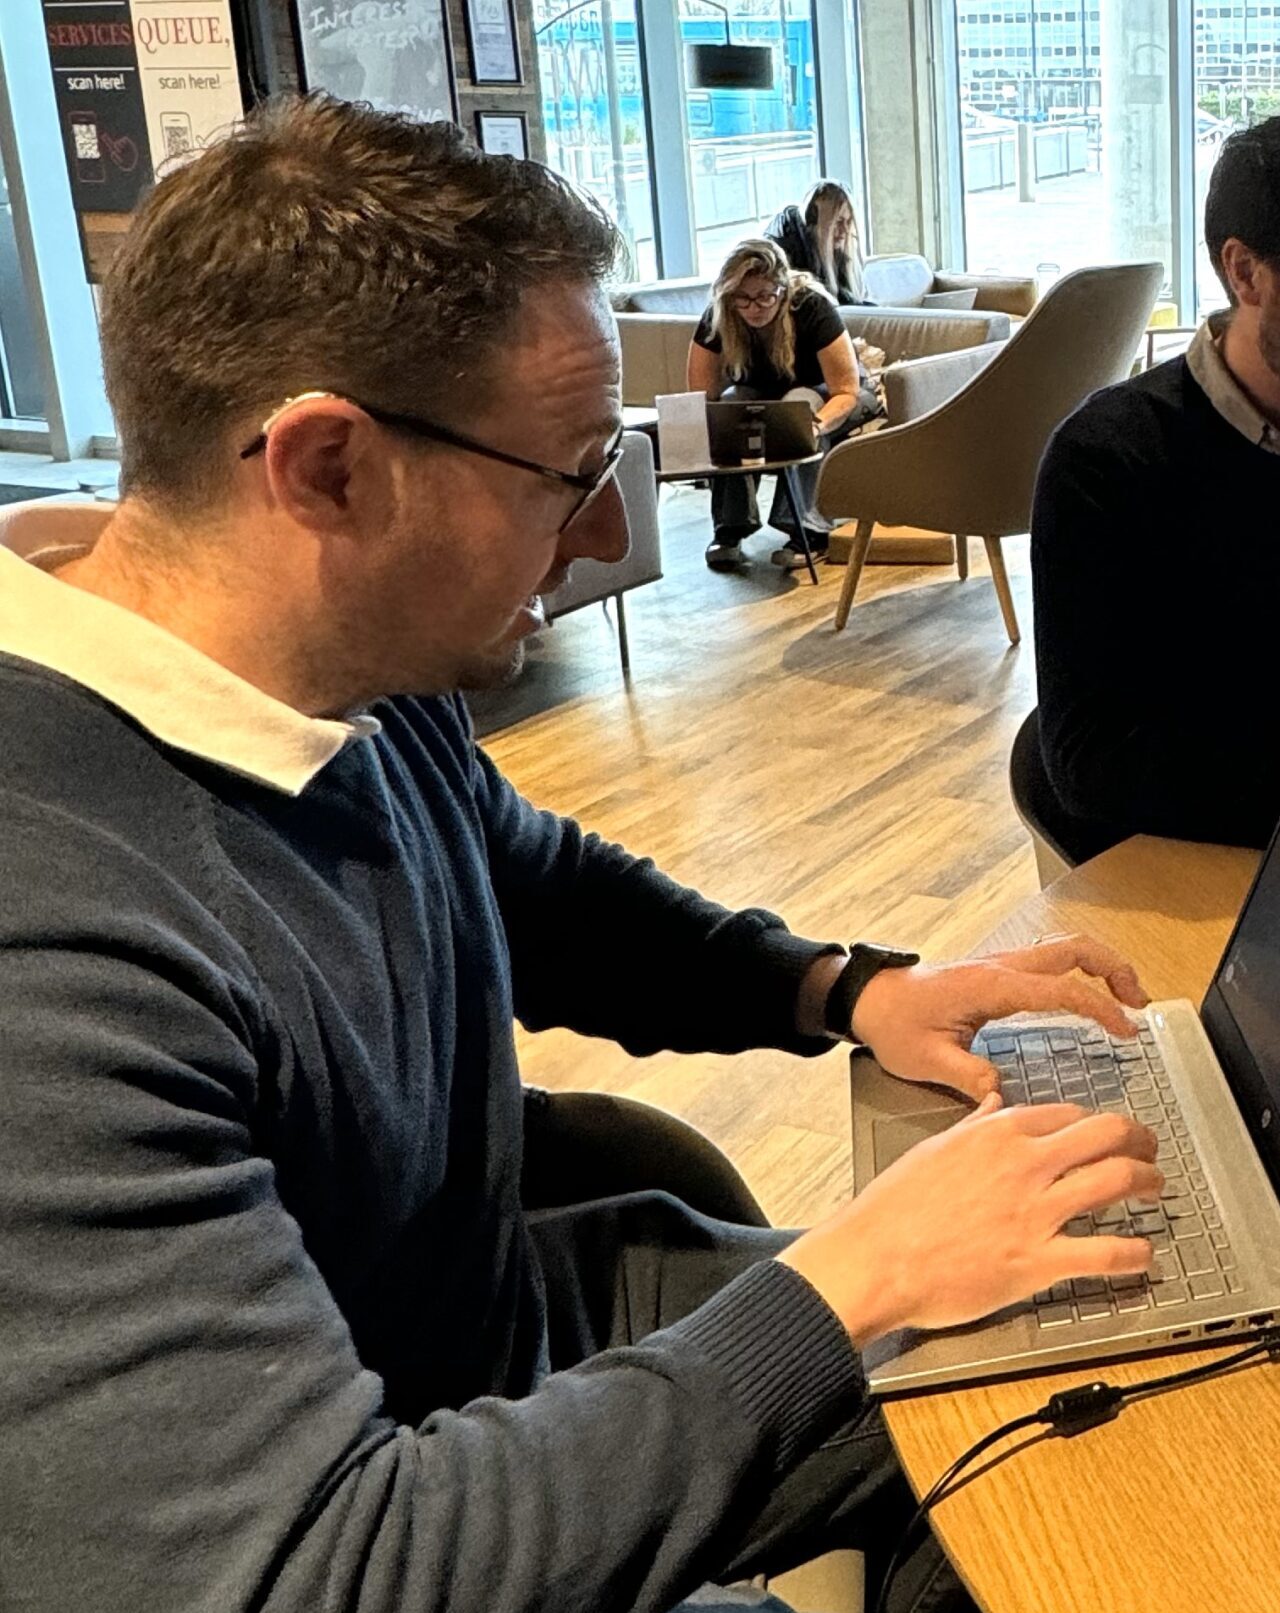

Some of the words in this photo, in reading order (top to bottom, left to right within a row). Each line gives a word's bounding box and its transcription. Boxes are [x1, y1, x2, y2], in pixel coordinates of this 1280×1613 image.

[48, 22, 132, 47] SERVICES
[137, 16, 231, 54] QUEUE,
[67, 75, 93, 91] scan
[94, 73, 126, 91] here!
[158, 76, 187, 90] scan
[188, 73, 222, 90] here!
